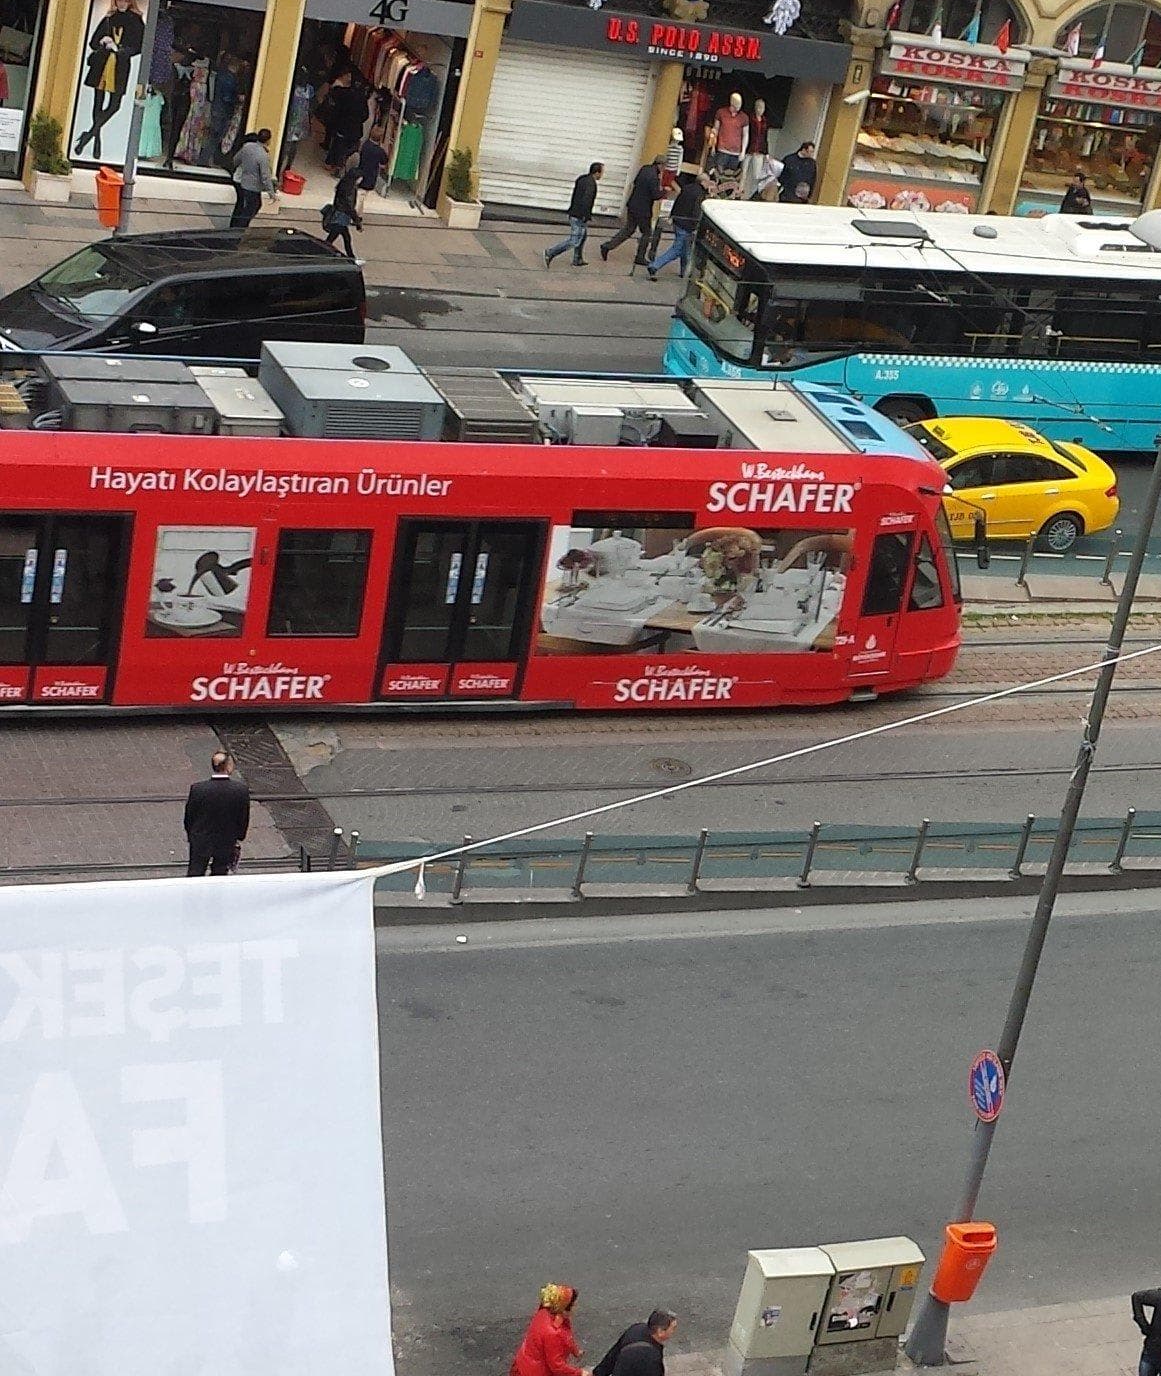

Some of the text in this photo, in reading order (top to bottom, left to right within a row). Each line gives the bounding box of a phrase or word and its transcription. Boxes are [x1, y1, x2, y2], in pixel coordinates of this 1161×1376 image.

[651, 23, 700, 52] POLO
[648, 45, 684, 58] SINCE
[902, 46, 1011, 72] KOSKA
[90, 466, 453, 498] Hayatı Kolaylaştıran Ürünler
[706, 482, 855, 513] SCHAFER
[41, 685, 99, 697] SCHAFER
[190, 675, 326, 701] SCHAFER
[388, 680, 441, 691] SCHAFER
[458, 678, 510, 690] SCHAFER
[613, 677, 733, 702] SCHAFER
